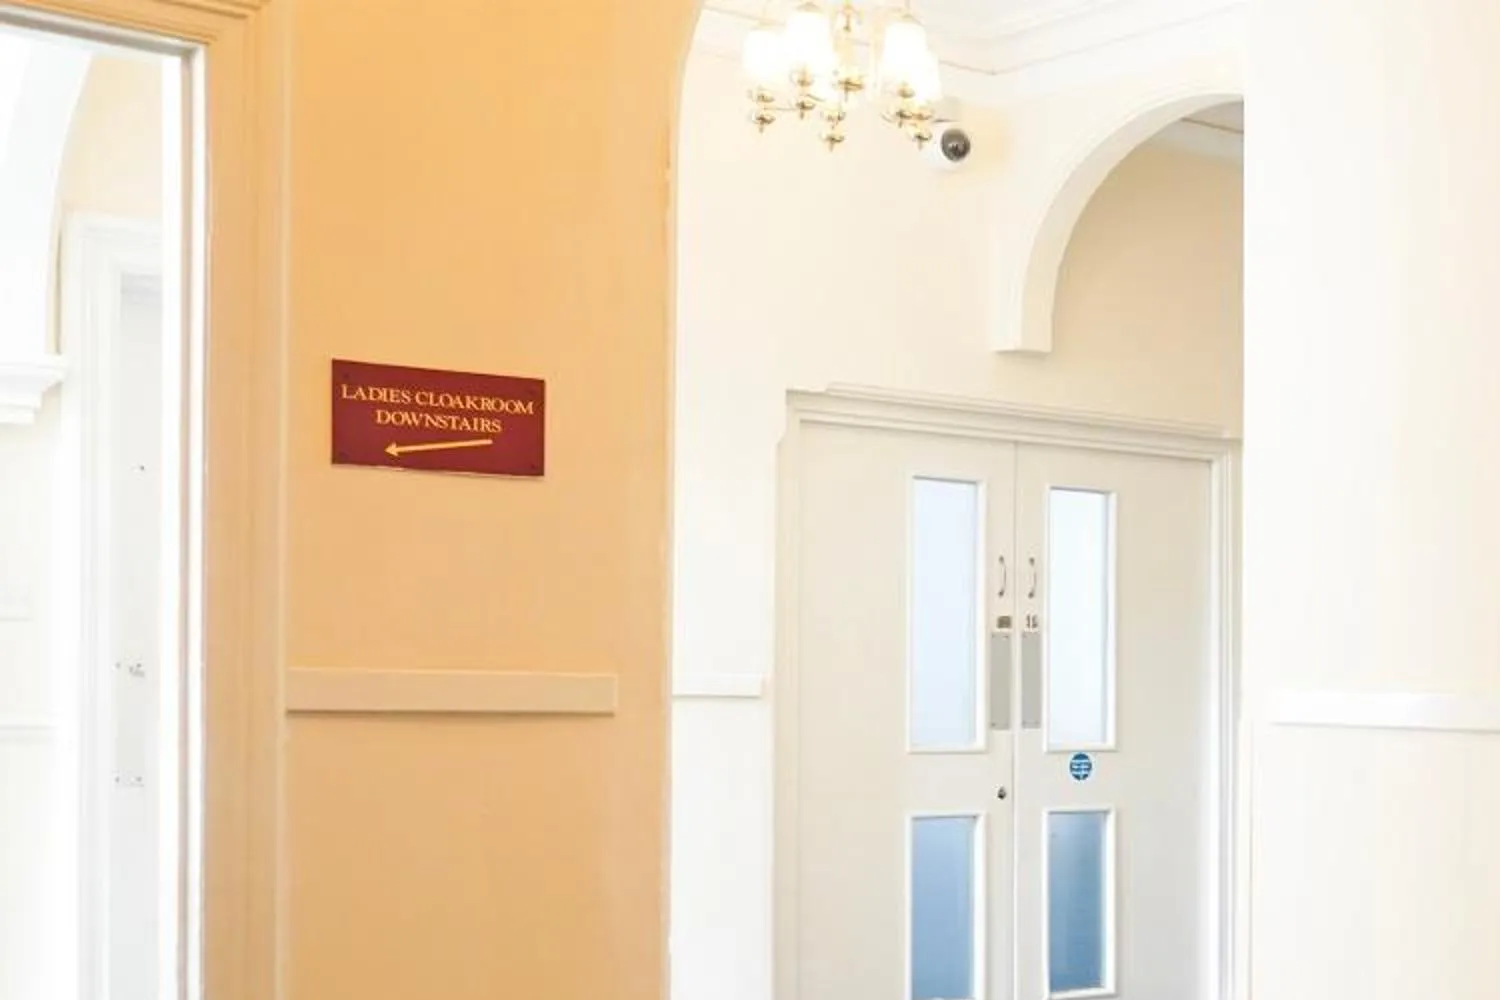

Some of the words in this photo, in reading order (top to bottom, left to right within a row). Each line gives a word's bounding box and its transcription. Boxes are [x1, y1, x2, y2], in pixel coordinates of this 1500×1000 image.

[341, 383, 411, 404] LADIES
[415, 391, 534, 415] CLOAKROOM
[376, 409, 502, 433] DOWNSTAIRS
